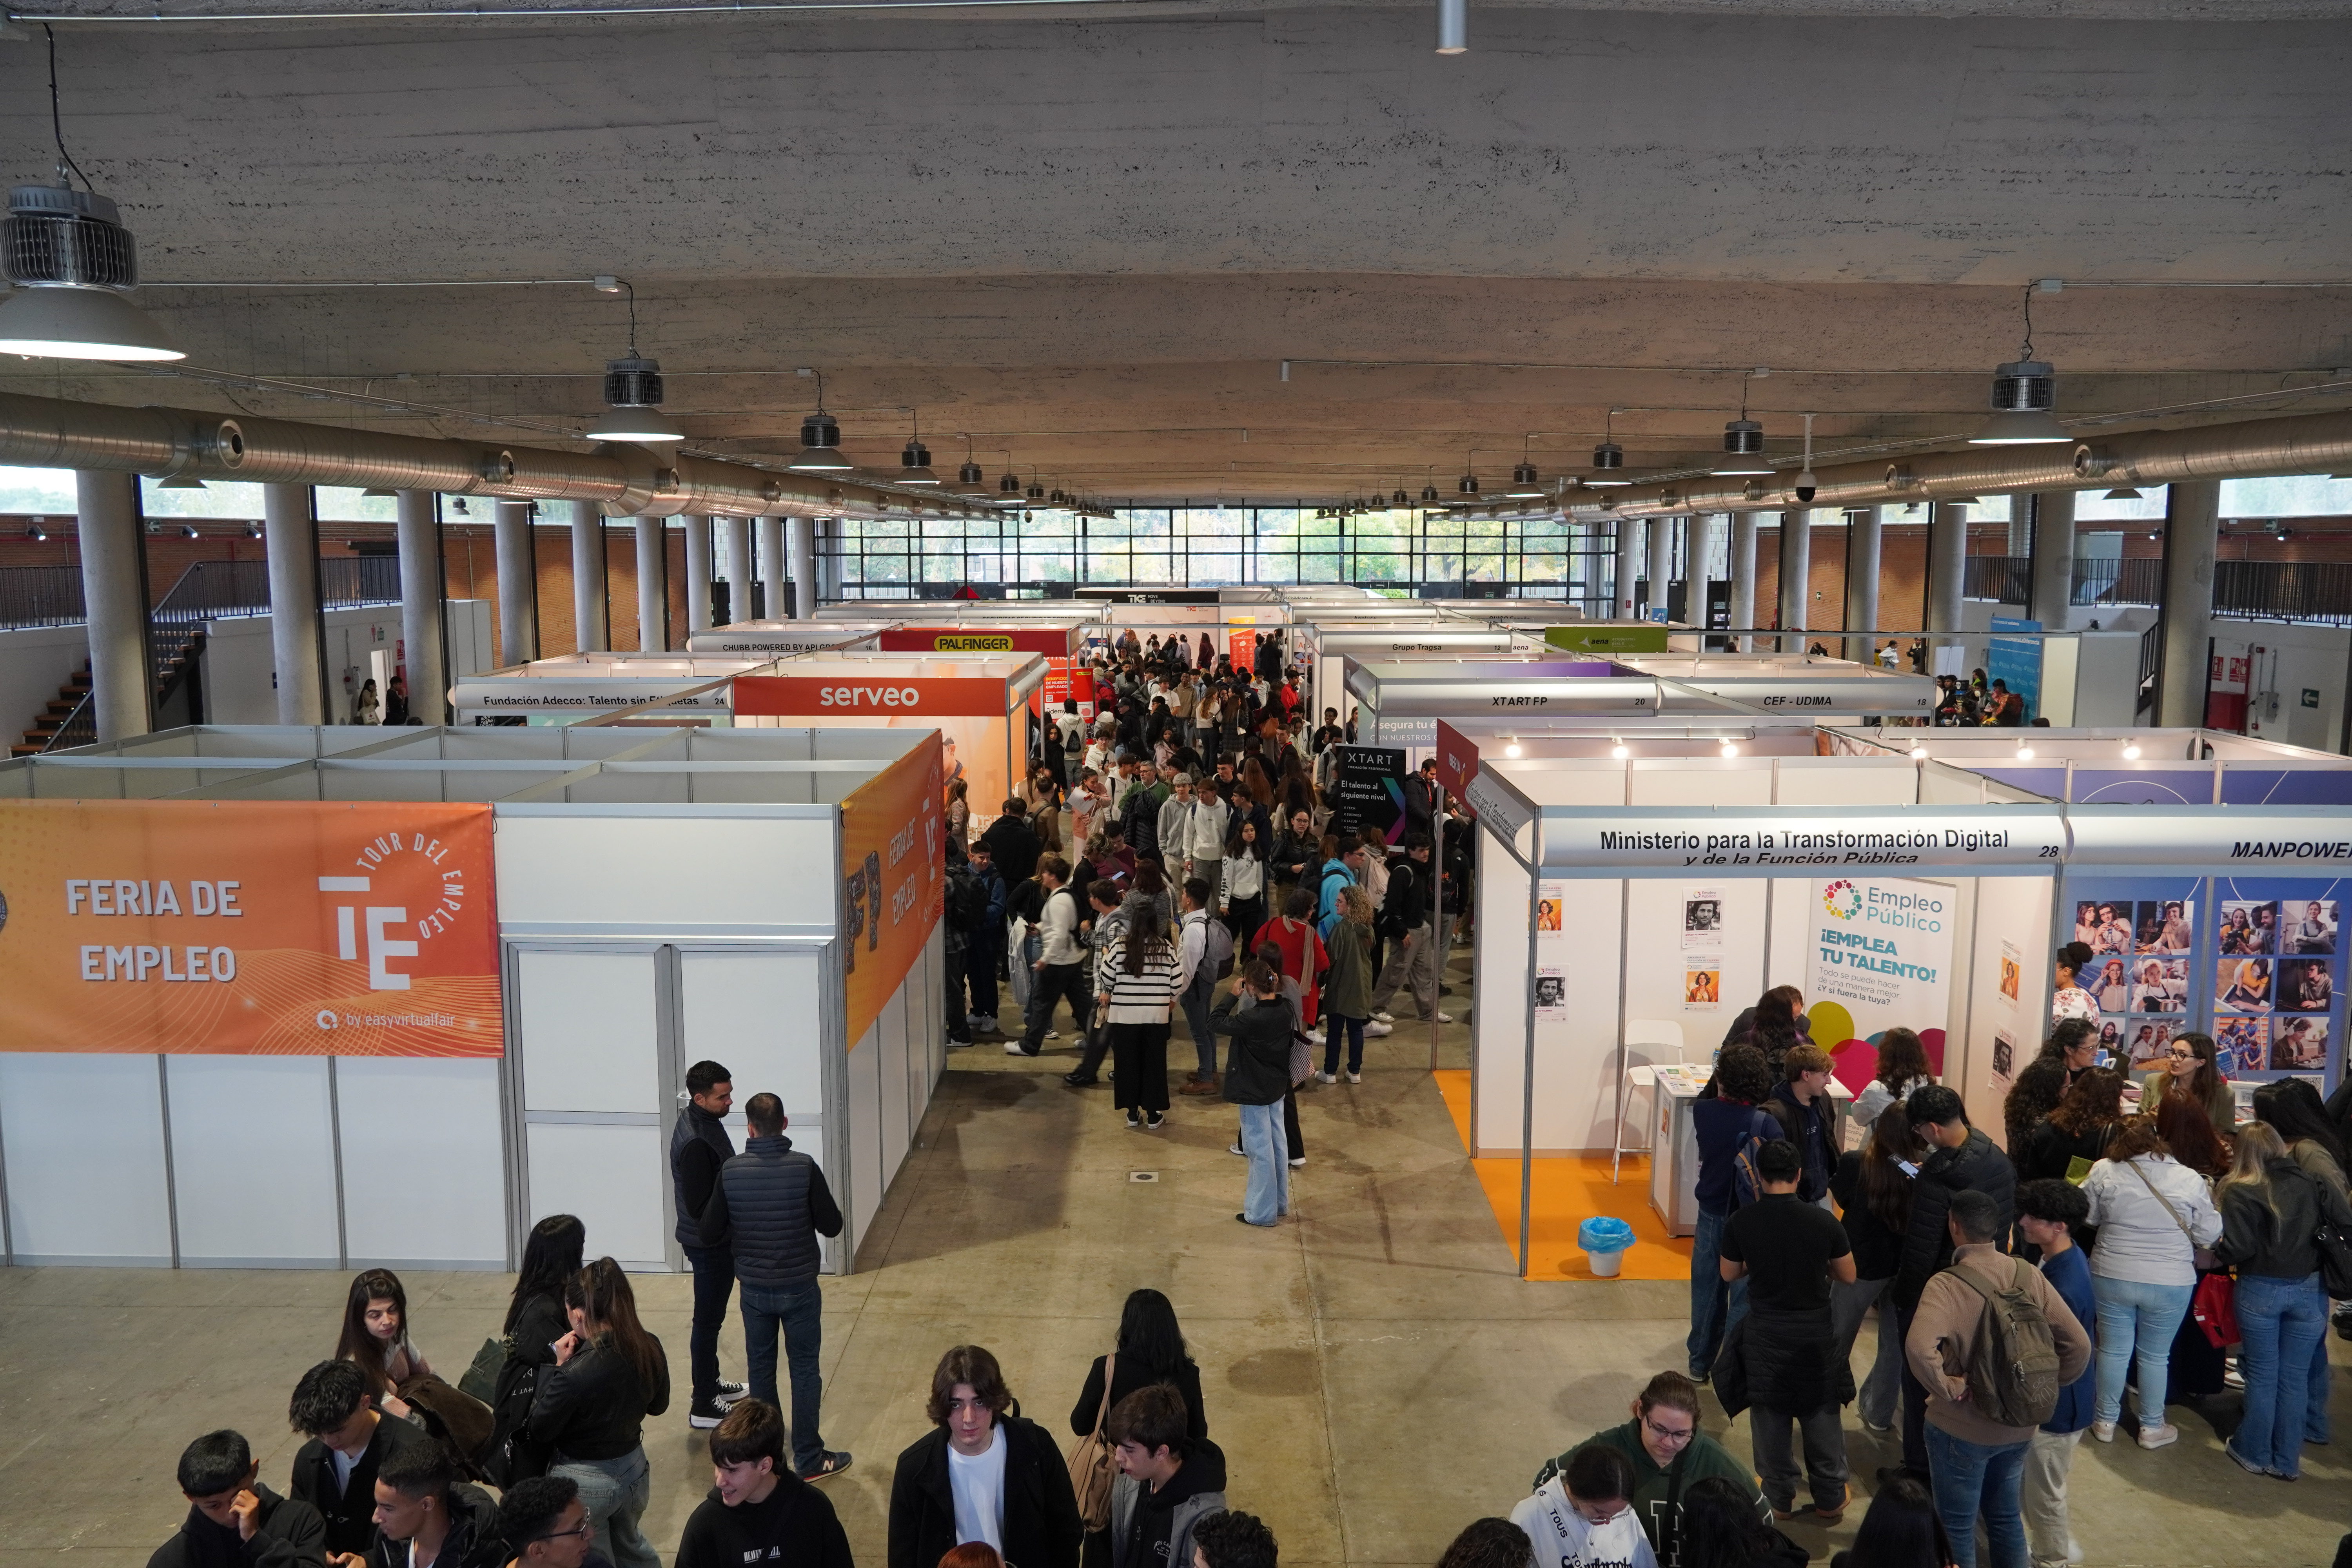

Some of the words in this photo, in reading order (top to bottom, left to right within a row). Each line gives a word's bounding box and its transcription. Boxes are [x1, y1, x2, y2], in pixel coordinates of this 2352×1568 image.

[939, 638, 1009, 650] PALFINGER
[484, 695, 539, 706] Fundación
[543, 696, 586, 705] Adecco:
[588, 696, 627, 705] Talento
[631, 696, 646, 706] sin
[820, 687, 919, 706] serveo
[1492, 697, 1531, 706] XTART
[1533, 697, 1548, 706] FP
[1764, 697, 1786, 706] CEF
[1796, 696, 1832, 706] UDIMA
[1417, 720, 1427, 729] tu
[1348, 753, 1392, 765] XTART
[1448, 752, 1460, 774] IBERIA
[1341, 792, 1369, 801] siguiente
[1490, 804, 1518, 842] Transformación
[356, 832, 404, 871] TOUR
[413, 833, 444, 866] DEL
[889, 826, 906, 871] FERIA
[906, 817, 916, 851] DE
[1601, 831, 1700, 849] Ministerio
[1707, 834, 1750, 853] para
[1757, 831, 1773, 848] la
[1780, 829, 1938, 848] Transformación
[1945, 829, 2008, 851] Digital
[2038, 846, 2059, 857] 28
[2230, 842, 2352, 858] MANPOWE
[1683, 856, 1698, 866] y
[1702, 853, 1726, 864] de
[1733, 853, 1750, 864] la
[1755, 852, 1838, 864] Función
[1843, 852, 1919, 864] Pública
[66, 879, 183, 916] FERIA
[191, 881, 243, 916] DE
[419, 869, 464, 940] EMPLEO
[892, 873, 916, 927] EMPLEO
[1868, 887, 1943, 913] Empleo
[1867, 906, 1941, 933] Público
[1821, 929, 1898, 956] ¡EMPLEA
[81, 946, 236, 982] EMPLEO
[1820, 947, 1844, 964] TU
[1847, 953, 1937, 983] TALENTO!
[1819, 967, 1838, 977] Todo
[1851, 975, 1876, 985] puede
[1878, 978, 1900, 989] hacer
[1837, 988, 1857, 998] fuera
[1868, 995, 1891, 1005] tuya?
[1846, 982, 1875, 994] manera
[1877, 989, 1901, 999] mejor.
[346, 1013, 361, 1028] by
[365, 1013, 456, 1027] easyvirtualfair
[1550, 1508, 1568, 1538] TOUS
